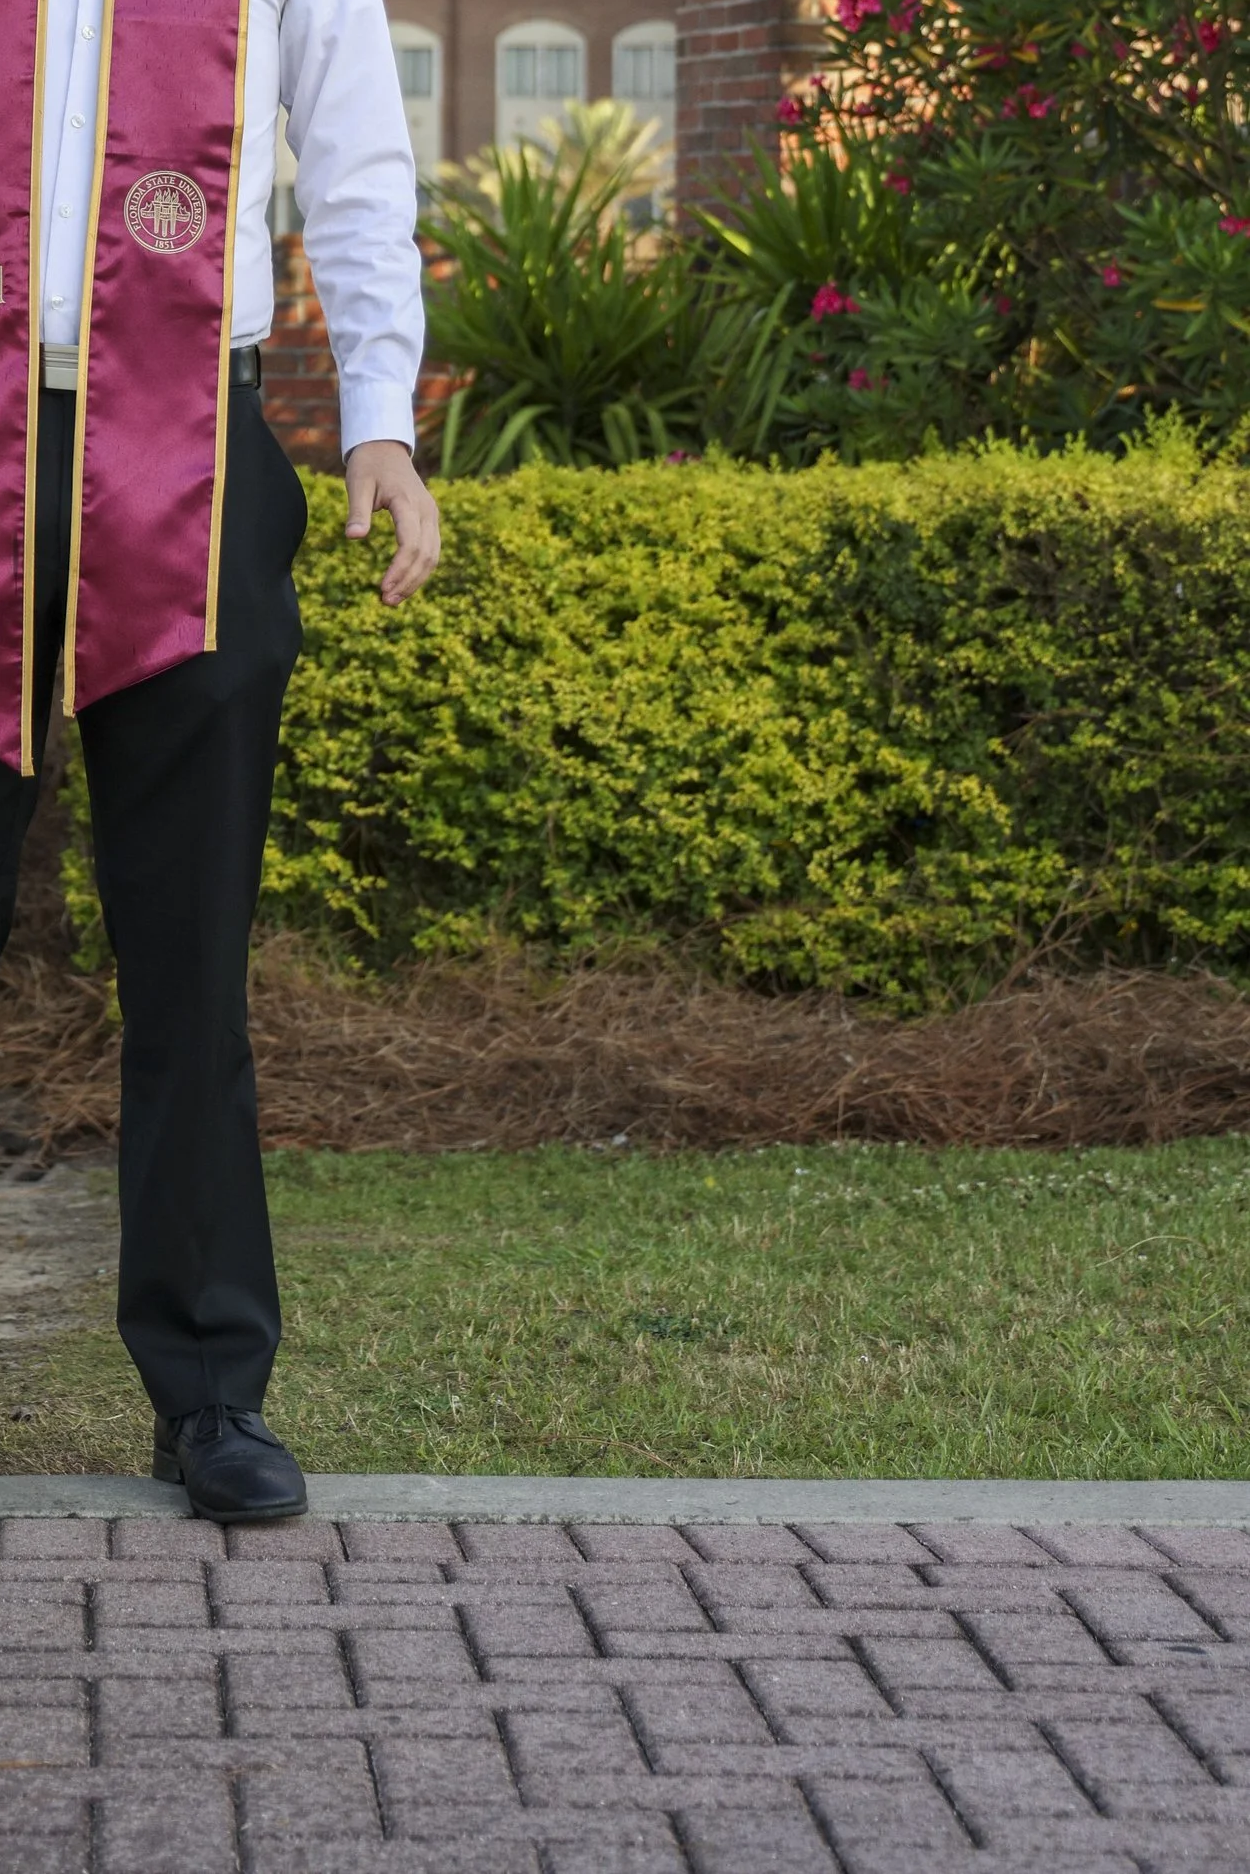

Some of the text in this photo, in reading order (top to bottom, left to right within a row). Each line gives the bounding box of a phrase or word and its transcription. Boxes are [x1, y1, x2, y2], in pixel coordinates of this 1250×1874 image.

[129, 176, 202, 237] FLORIDA STATE UNIVERSITY
[154, 240, 175, 249] 1851
